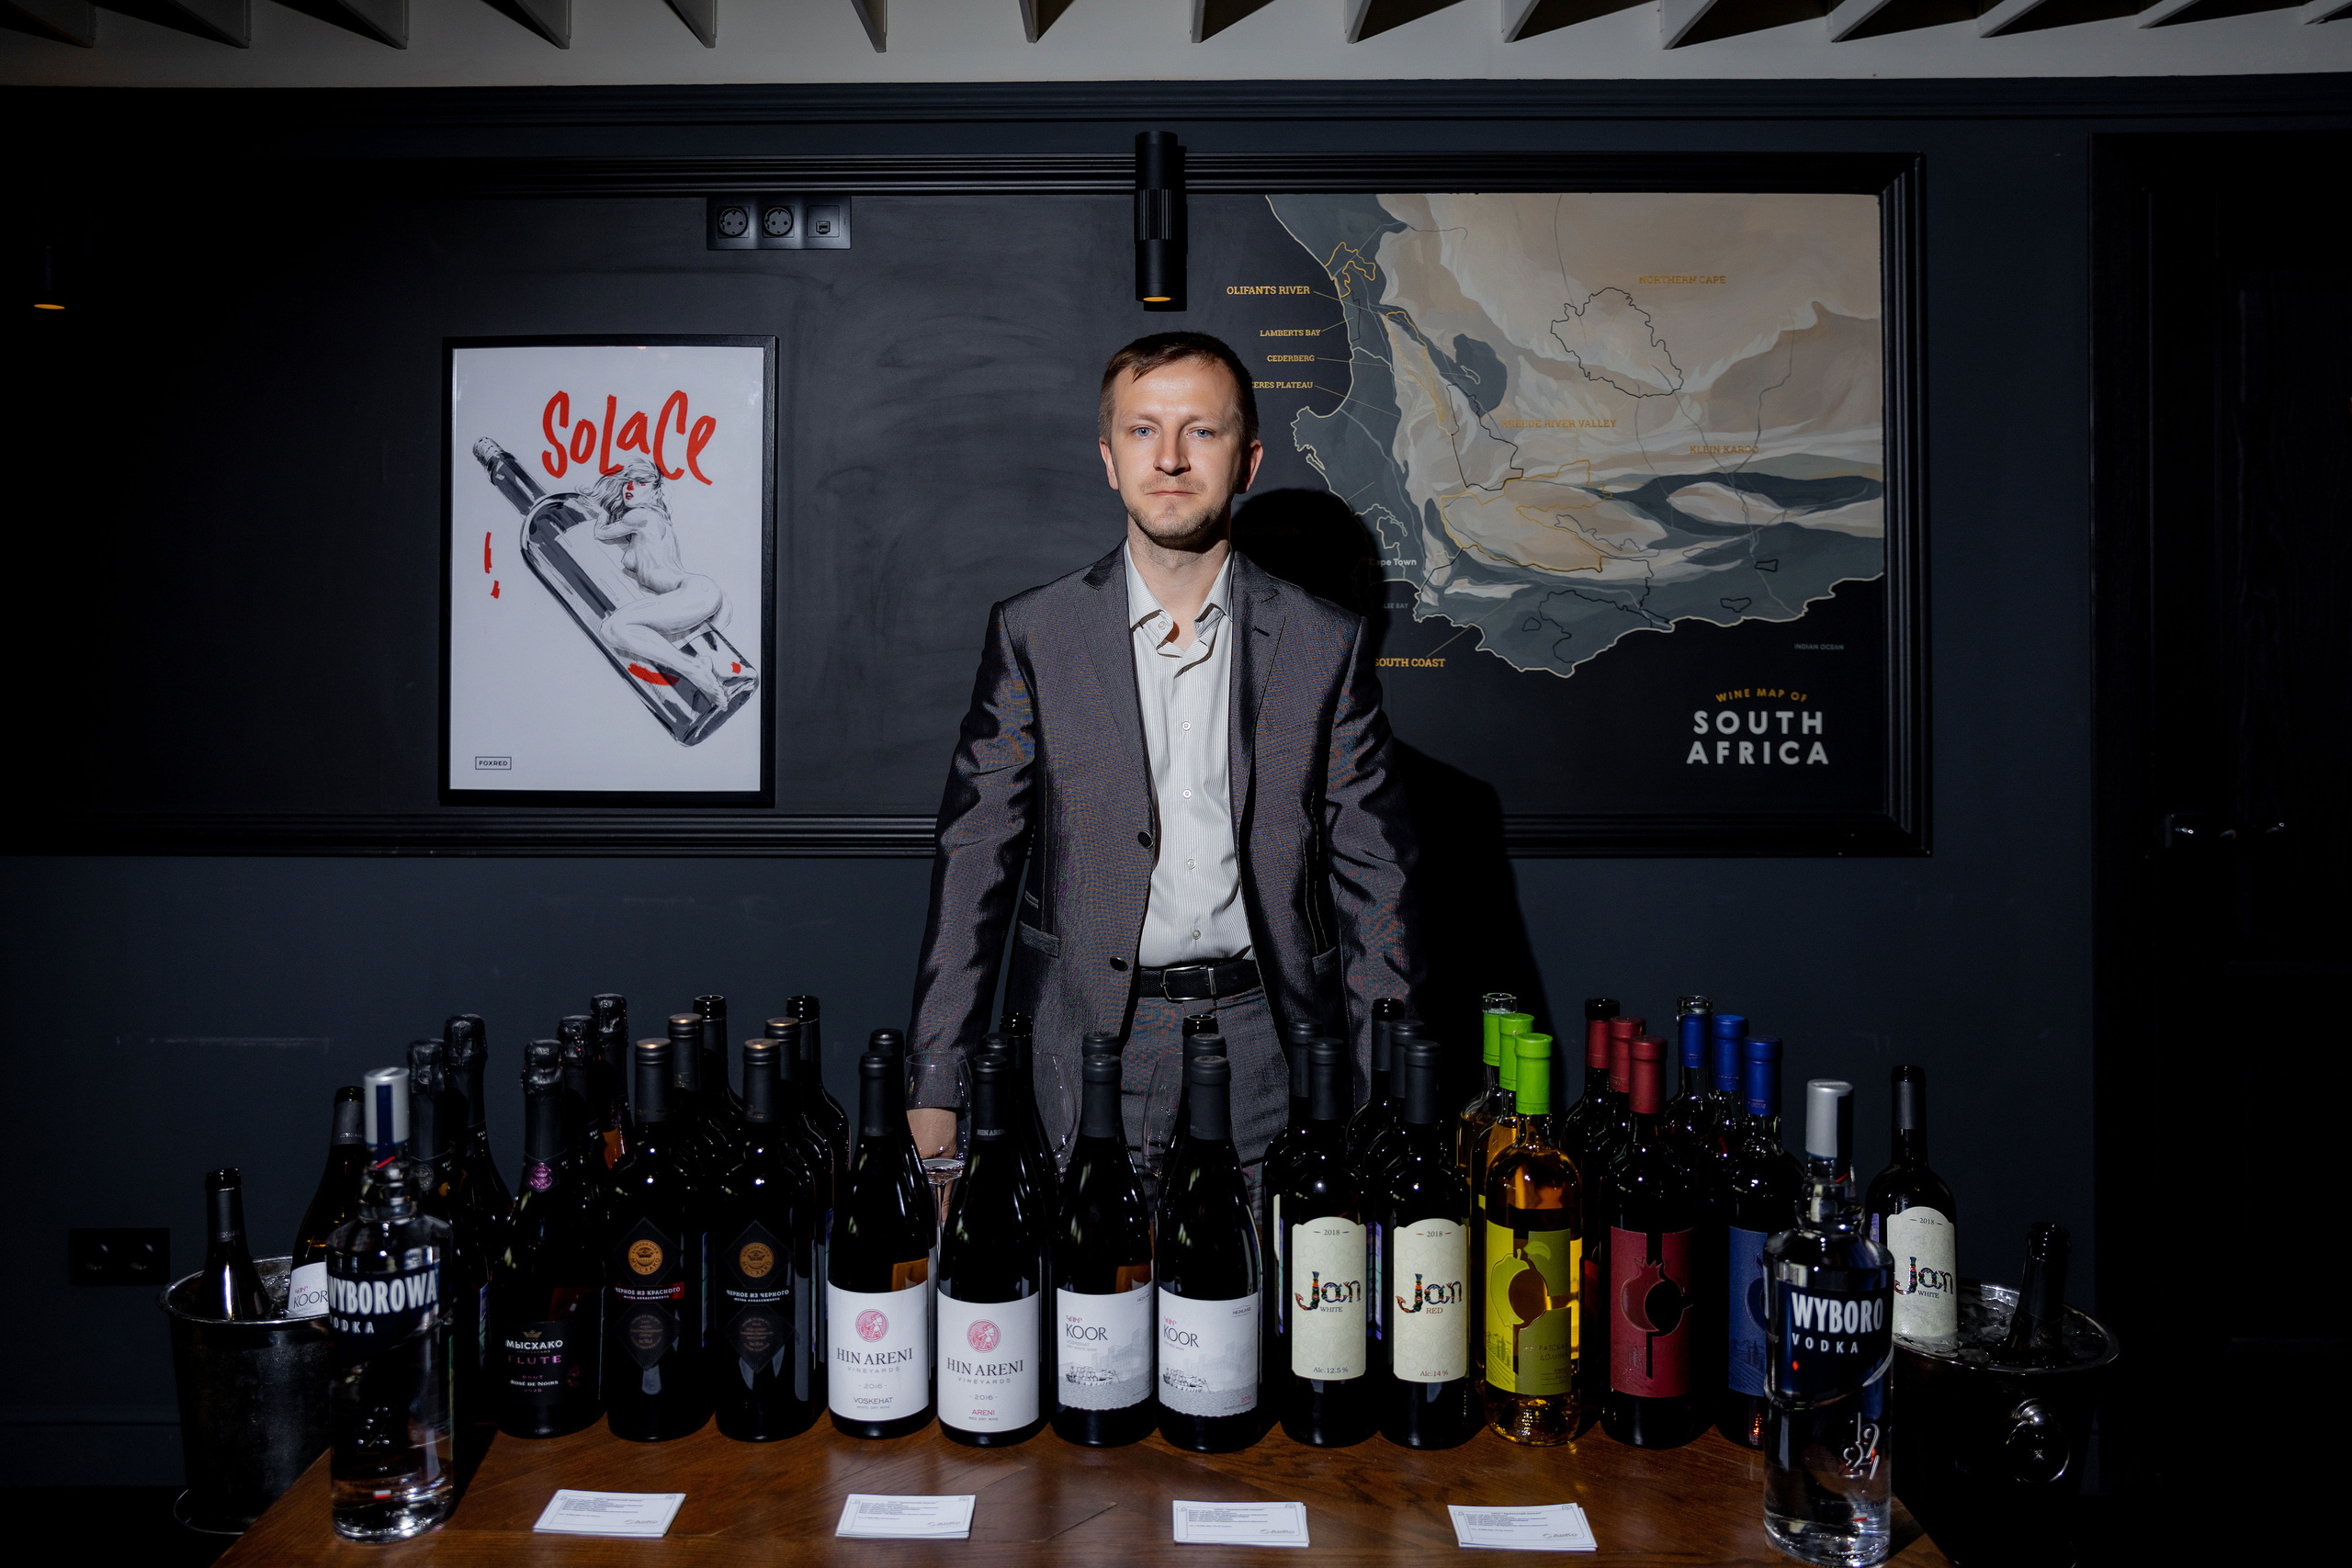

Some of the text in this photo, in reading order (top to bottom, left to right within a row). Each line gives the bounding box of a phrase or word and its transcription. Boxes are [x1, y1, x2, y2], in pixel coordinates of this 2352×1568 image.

[1639, 276, 1725, 285] NORTHERN CAPE
[1227, 286, 1310, 295] OLIFANTS RIVER
[1544, 420, 1577, 429] RIVER
[1578, 420, 1617, 429] VALLEY
[1690, 446, 1721, 455] KLEIN
[1410, 658, 1446, 667] COAST
[1715, 687, 1808, 703] WINE MAP OF
[1693, 710, 1823, 735] SOUTH
[1686, 740, 1829, 765] AFRICA
[327, 1270, 438, 1315] WYBOROWA
[647, 1287, 681, 1296] КРАСНОГО
[759, 1289, 790, 1298] ЧЕРНОГО
[1918, 1290, 1939, 1299] WHITE
[293, 1290, 329, 1309] KOOR
[329, 1314, 375, 1335] ODKA
[1066, 1323, 1109, 1341] KOOR
[1163, 1324, 1200, 1348] KOOR
[505, 1339, 564, 1350] МЫСХАКО
[1792, 1332, 1860, 1354] VODKA
[508, 1354, 562, 1365] FLUTE
[837, 1348, 913, 1365] HIN ARENI
[847, 1366, 900, 1374] VINEYARDS
[947, 1357, 1023, 1376] HIN ARENI
[957, 1376, 1012, 1384] VINEYARDS
[853, 1396, 894, 1404] VOSKEHAT
